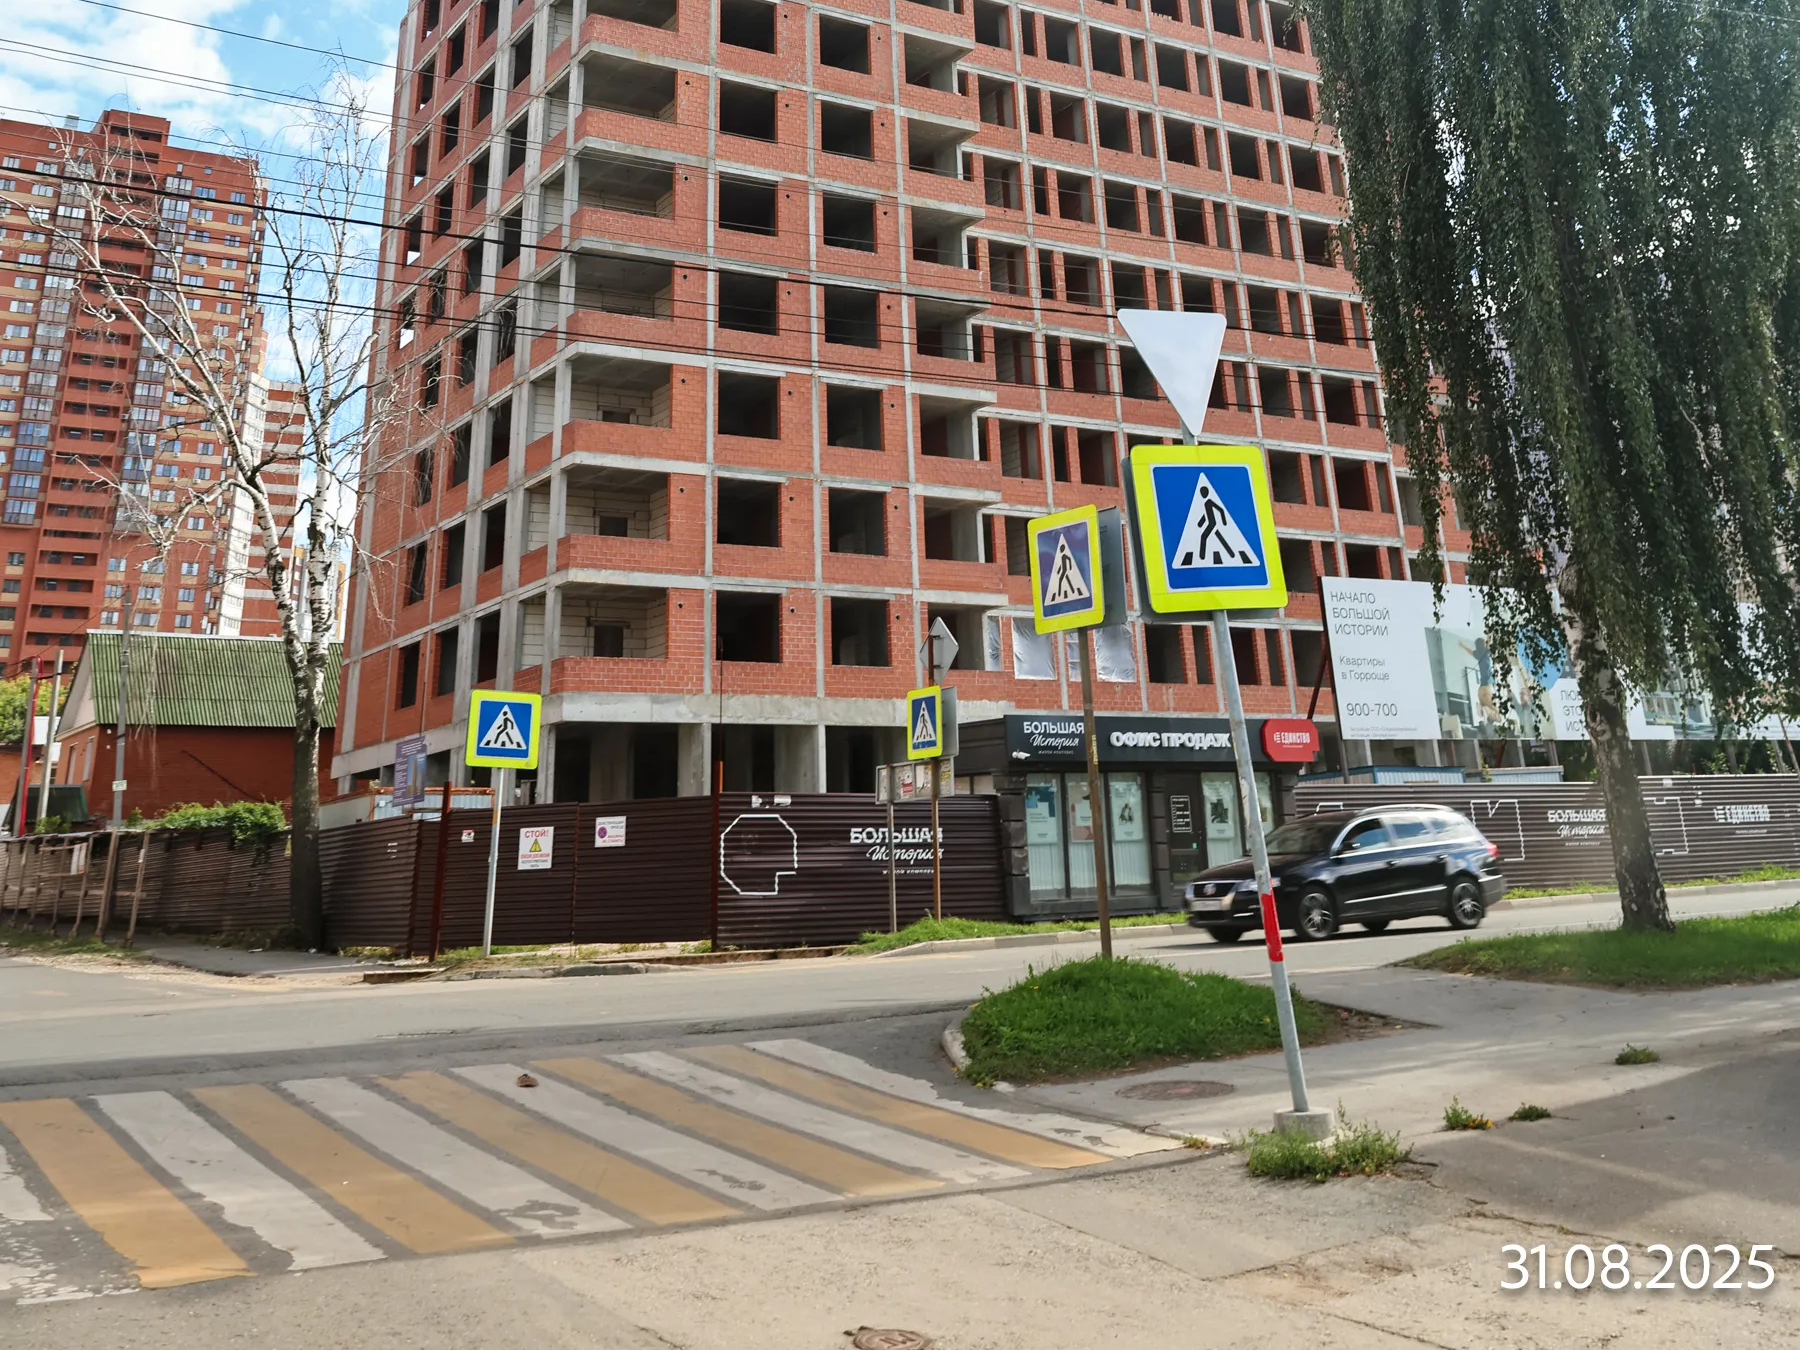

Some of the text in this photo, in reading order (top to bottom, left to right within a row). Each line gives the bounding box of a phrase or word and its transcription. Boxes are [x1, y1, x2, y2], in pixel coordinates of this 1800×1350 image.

[1330, 591, 1376, 604] НАЧАЛО
[1332, 607, 1390, 621] БОЛЬШОЙ
[1334, 623, 1389, 636] ИСТОРИИ
[1339, 655, 1385, 671] Квартиры
[1341, 670, 1390, 682] в Горроще
[1346, 702, 1398, 717] 900-700
[1022, 721, 1085, 735] БОЛЬШАЯ
[1029, 733, 1080, 750] История
[1109, 731, 1231, 750] ОФИС ПРОДАЖ
[1281, 731, 1311, 745] ЕДИНСТВО
[1547, 808, 1607, 823] БОЛЬШАЯ
[524, 828, 549, 839] СТОЙ!
